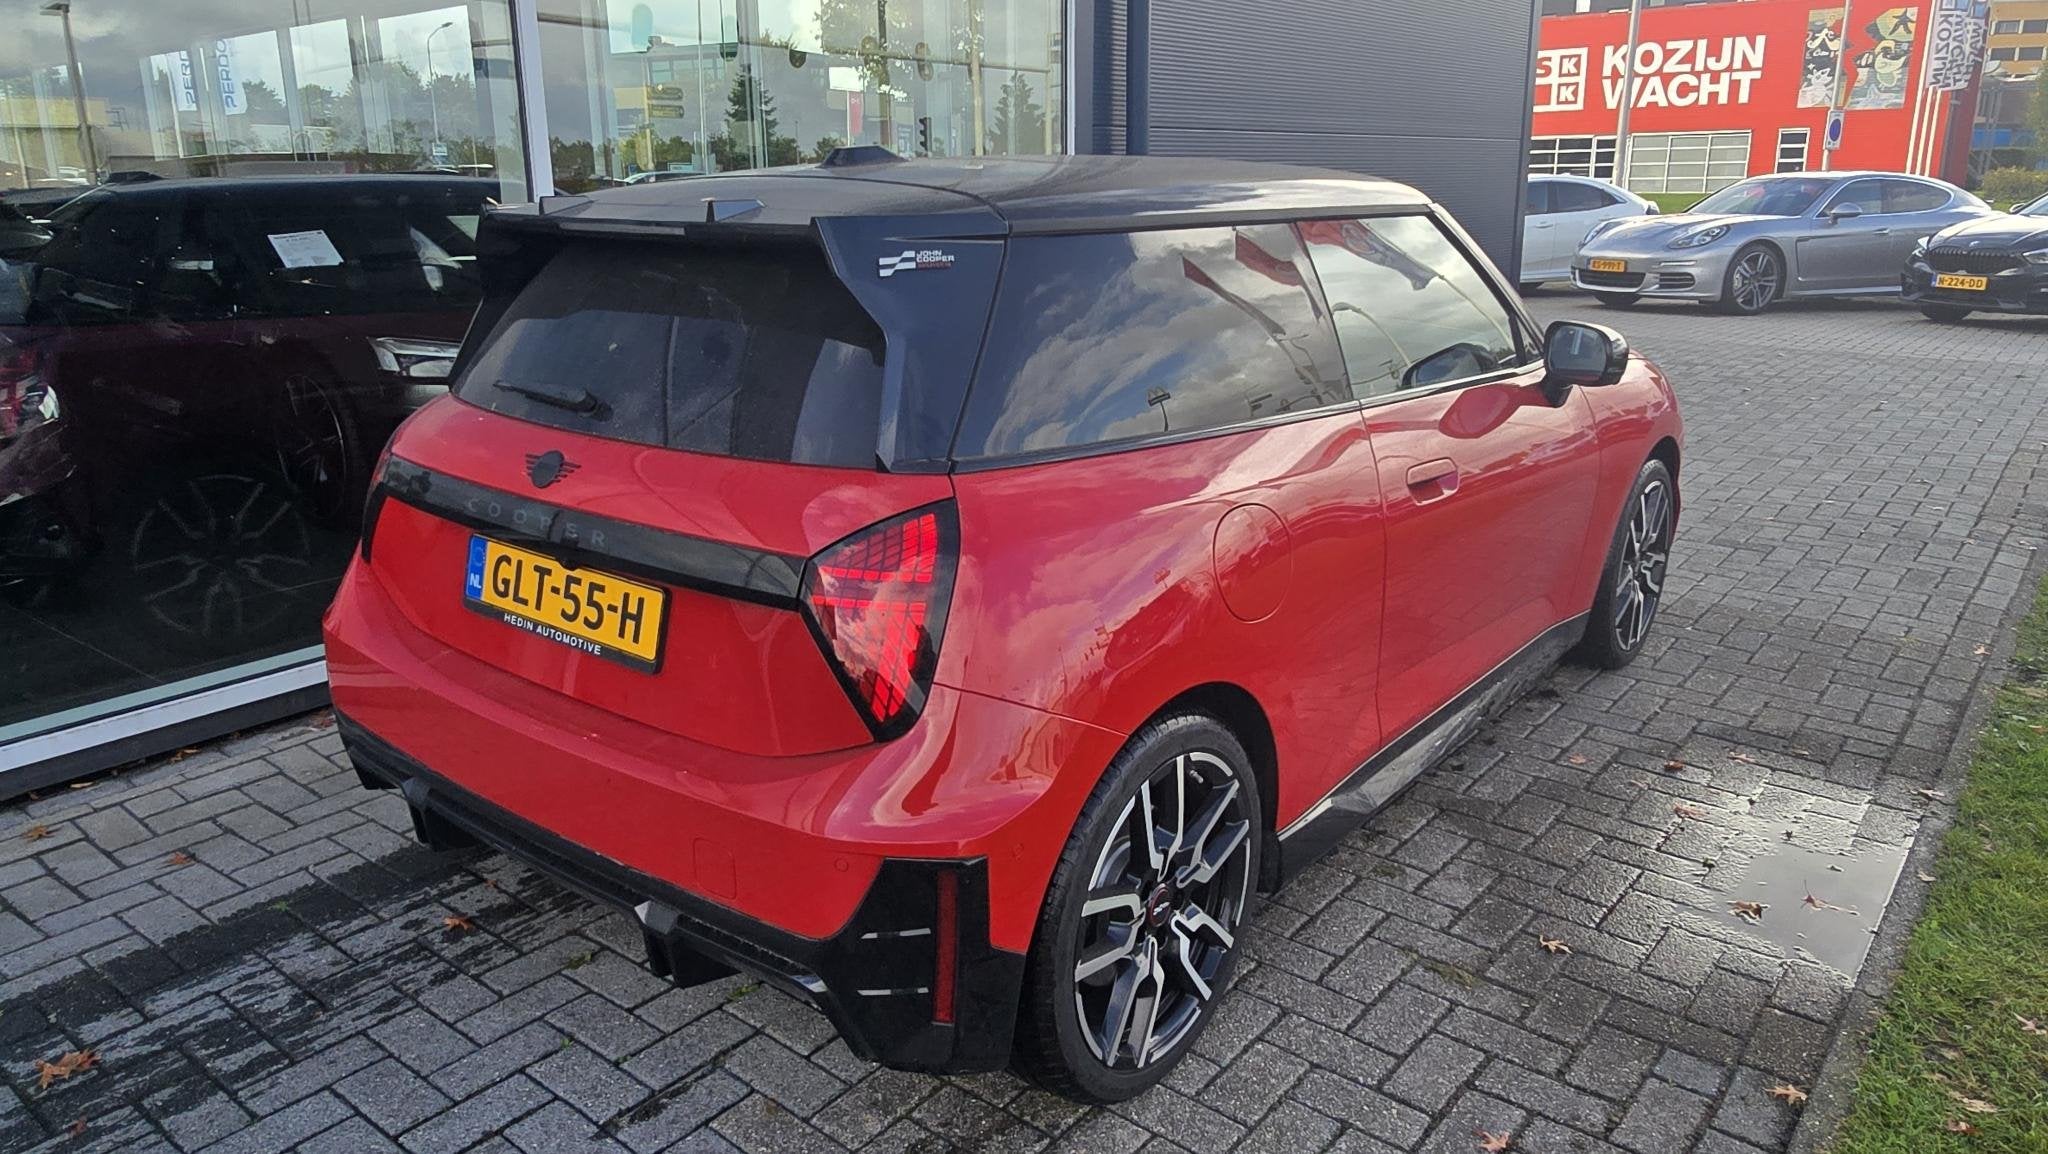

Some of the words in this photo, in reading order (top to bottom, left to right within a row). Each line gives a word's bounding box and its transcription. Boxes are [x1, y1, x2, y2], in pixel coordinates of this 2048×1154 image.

[1602, 34, 1766, 77] KOZIJN
[1602, 70, 1762, 110] WACHT
[916, 255, 955, 263] COOPER
[467, 498, 607, 547] COOPER
[469, 572, 482, 589] NL
[491, 554, 645, 645] GLT-55-H
[503, 613, 534, 632] HEDIN
[535, 626, 602, 656] AUTOMOTIVE
